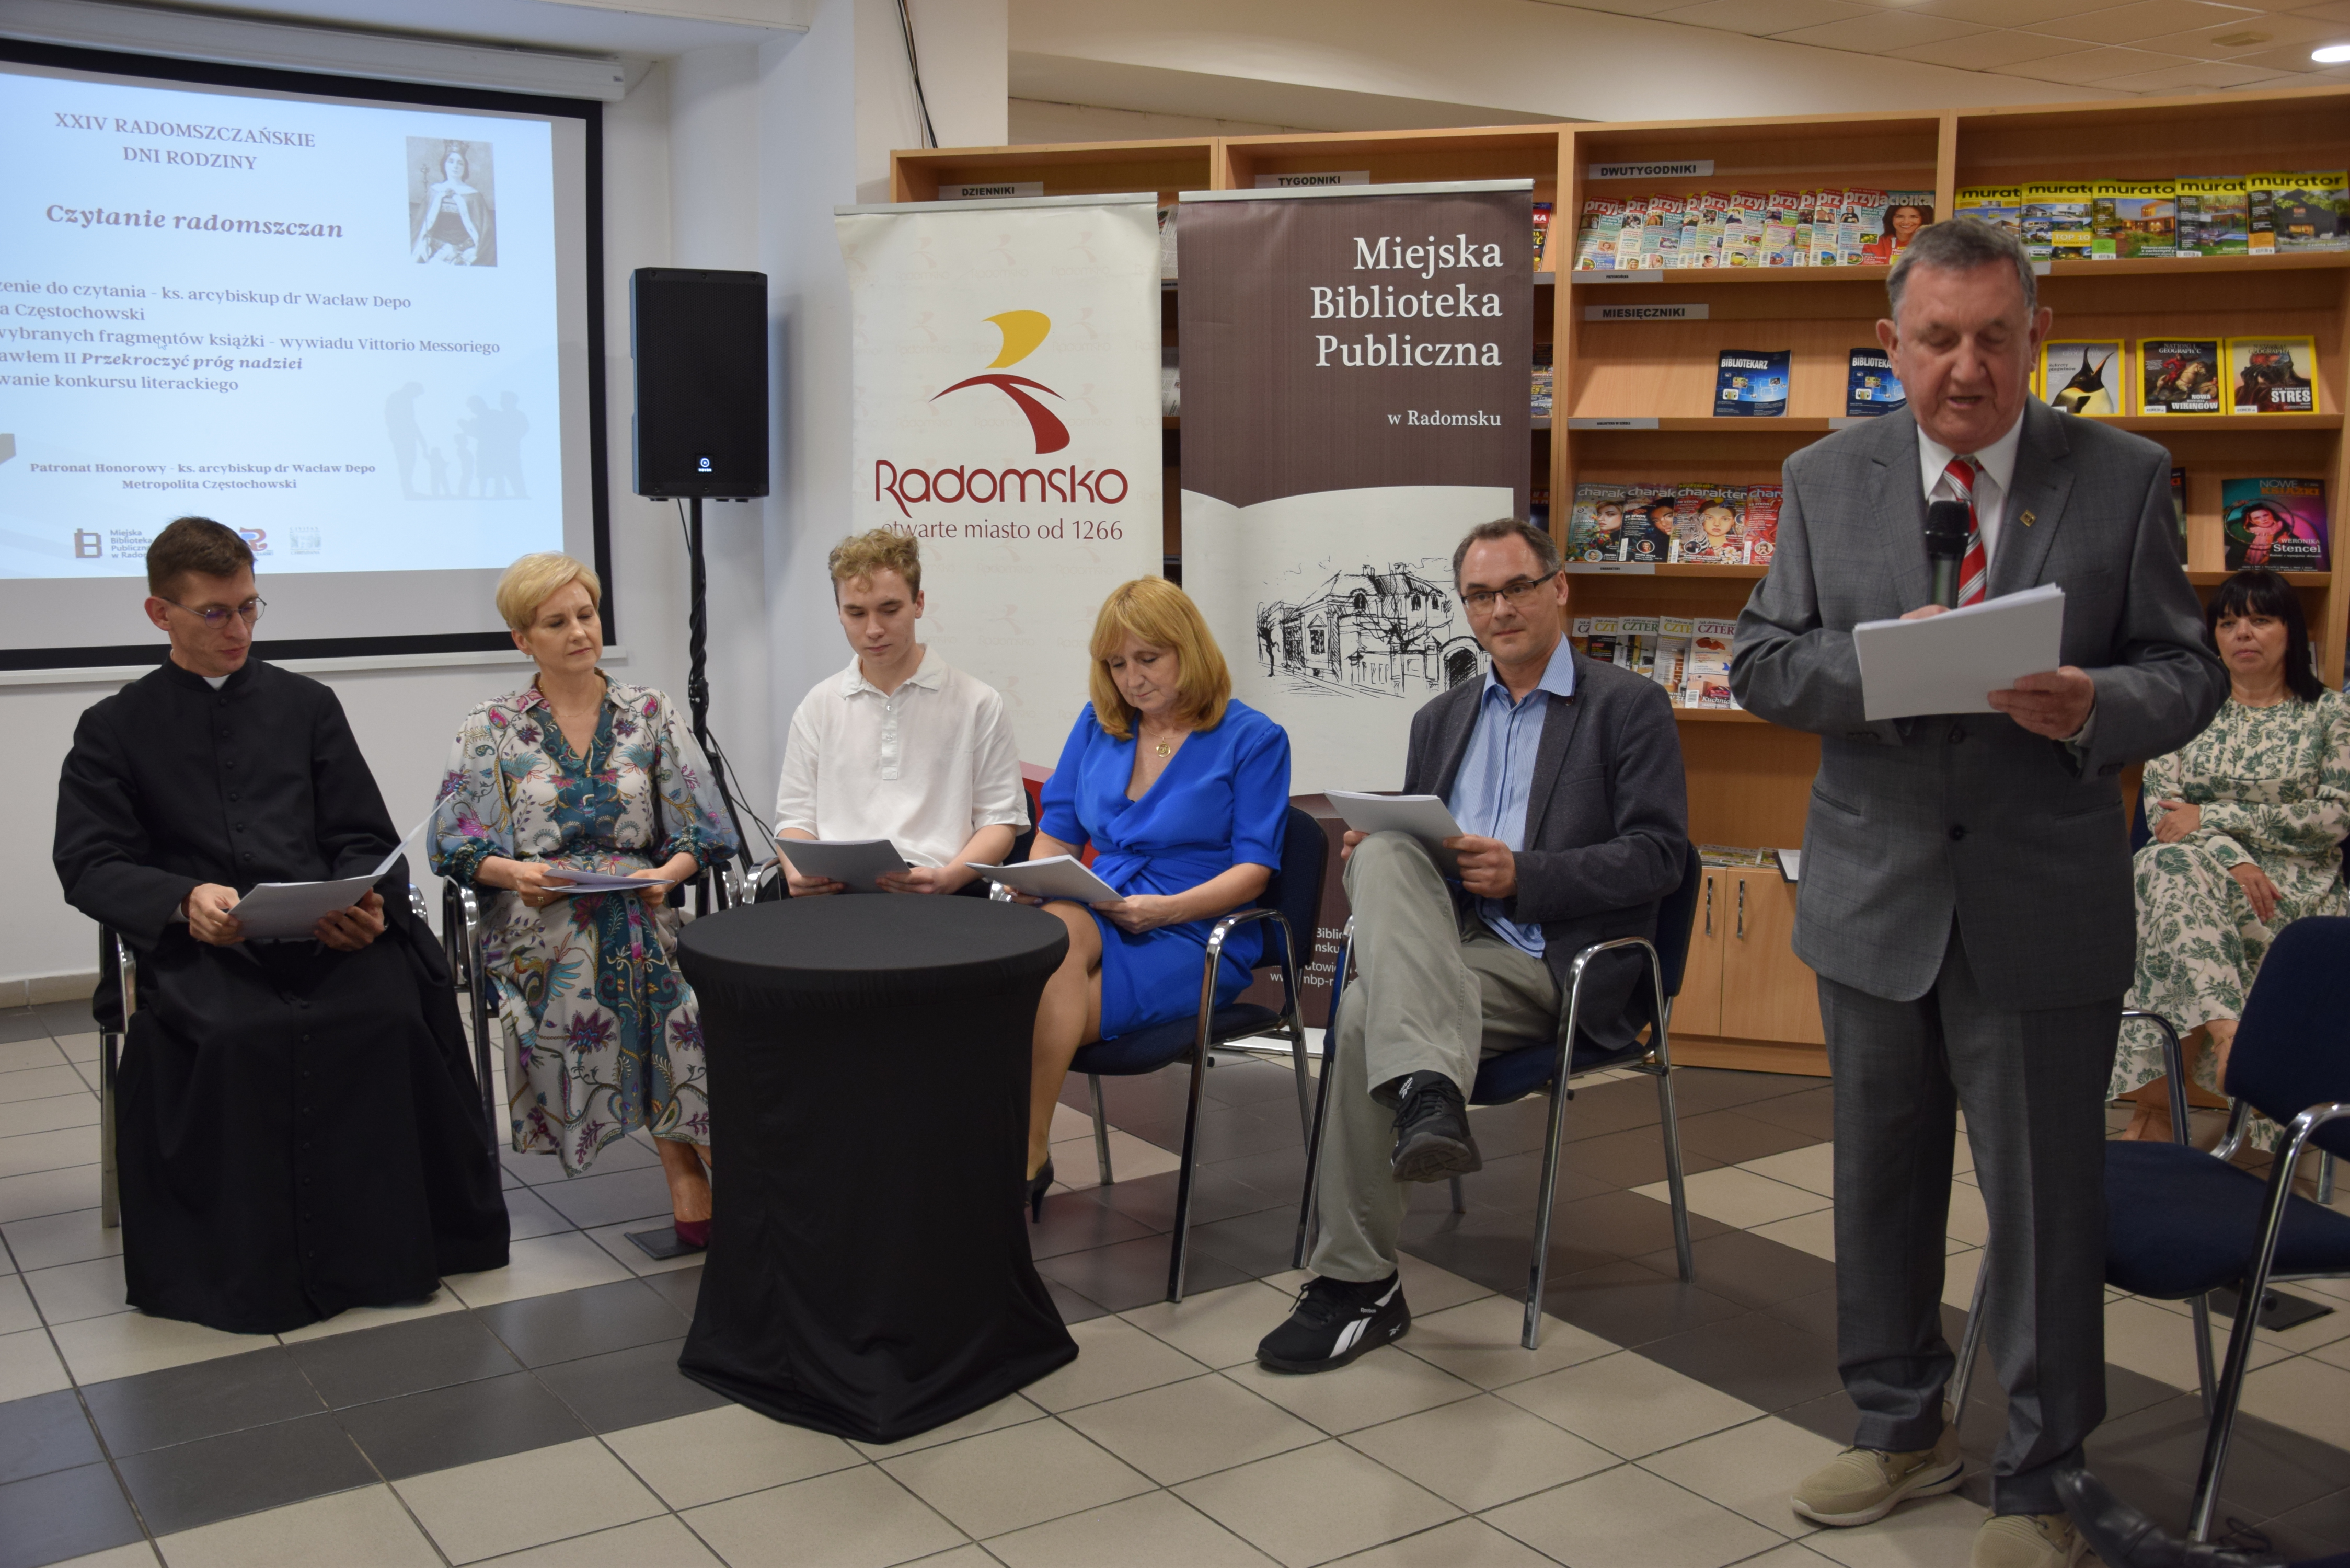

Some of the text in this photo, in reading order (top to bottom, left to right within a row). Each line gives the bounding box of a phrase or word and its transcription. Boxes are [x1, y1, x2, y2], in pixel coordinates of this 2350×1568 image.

[54, 113, 315, 148] XXIV RADOMSZCZAŃSKIE
[123, 147, 257, 170] DNI RODZINY
[1600, 165, 1697, 176] DWUTYGODNIKI
[1278, 175, 1341, 186] TYGODNIKI
[2251, 175, 2343, 187] murator
[962, 186, 1015, 197] DZIENNIKI
[1843, 192, 1933, 207] przyjaciółka
[46, 204, 343, 238] Czytanie radomszczan
[1353, 234, 1503, 279] Miejska
[46, 281, 68, 295] do
[73, 285, 146, 299] czytania
[162, 287, 183, 299] ks.
[188, 290, 280, 306] arcybiskup
[283, 291, 301, 305] dr
[305, 293, 368, 307] Wacław
[373, 296, 411, 310] Depo
[1310, 284, 1503, 319] Biblioteka
[15, 304, 145, 320] Częstochowski
[1602, 308, 1686, 319] MIESIĘCZNIKI
[99, 330, 204, 347] fragmentów
[209, 334, 264, 349] książki
[280, 337, 353, 351] wywiadu
[358, 338, 415, 351] Vittorio
[419, 340, 500, 355] Messoriego
[1315, 334, 1502, 367] Publiczna
[64, 352, 76, 364] II
[81, 353, 189, 369] Przekroczyć
[193, 356, 234, 371] próg
[239, 358, 303, 370] nadziei
[1721, 358, 1768, 370] BIBLIOTEKARZ
[54, 374, 137, 389] konkursu
[142, 376, 239, 393] literackiego
[2271, 390, 2311, 403] STRES
[1388, 410, 1502, 426] w Radomsku
[30, 463, 376, 475] Patronat Honorowy ks. arcybiskup dr Wacław Depo
[122, 479, 297, 491] Metropolita Częstochowski
[876, 459, 1128, 519] Radomsko
[965, 519, 1030, 539] miasto
[1037, 518, 1063, 539] od
[1072, 521, 1123, 540] 1266
[2273, 544, 2321, 553] Stencel
